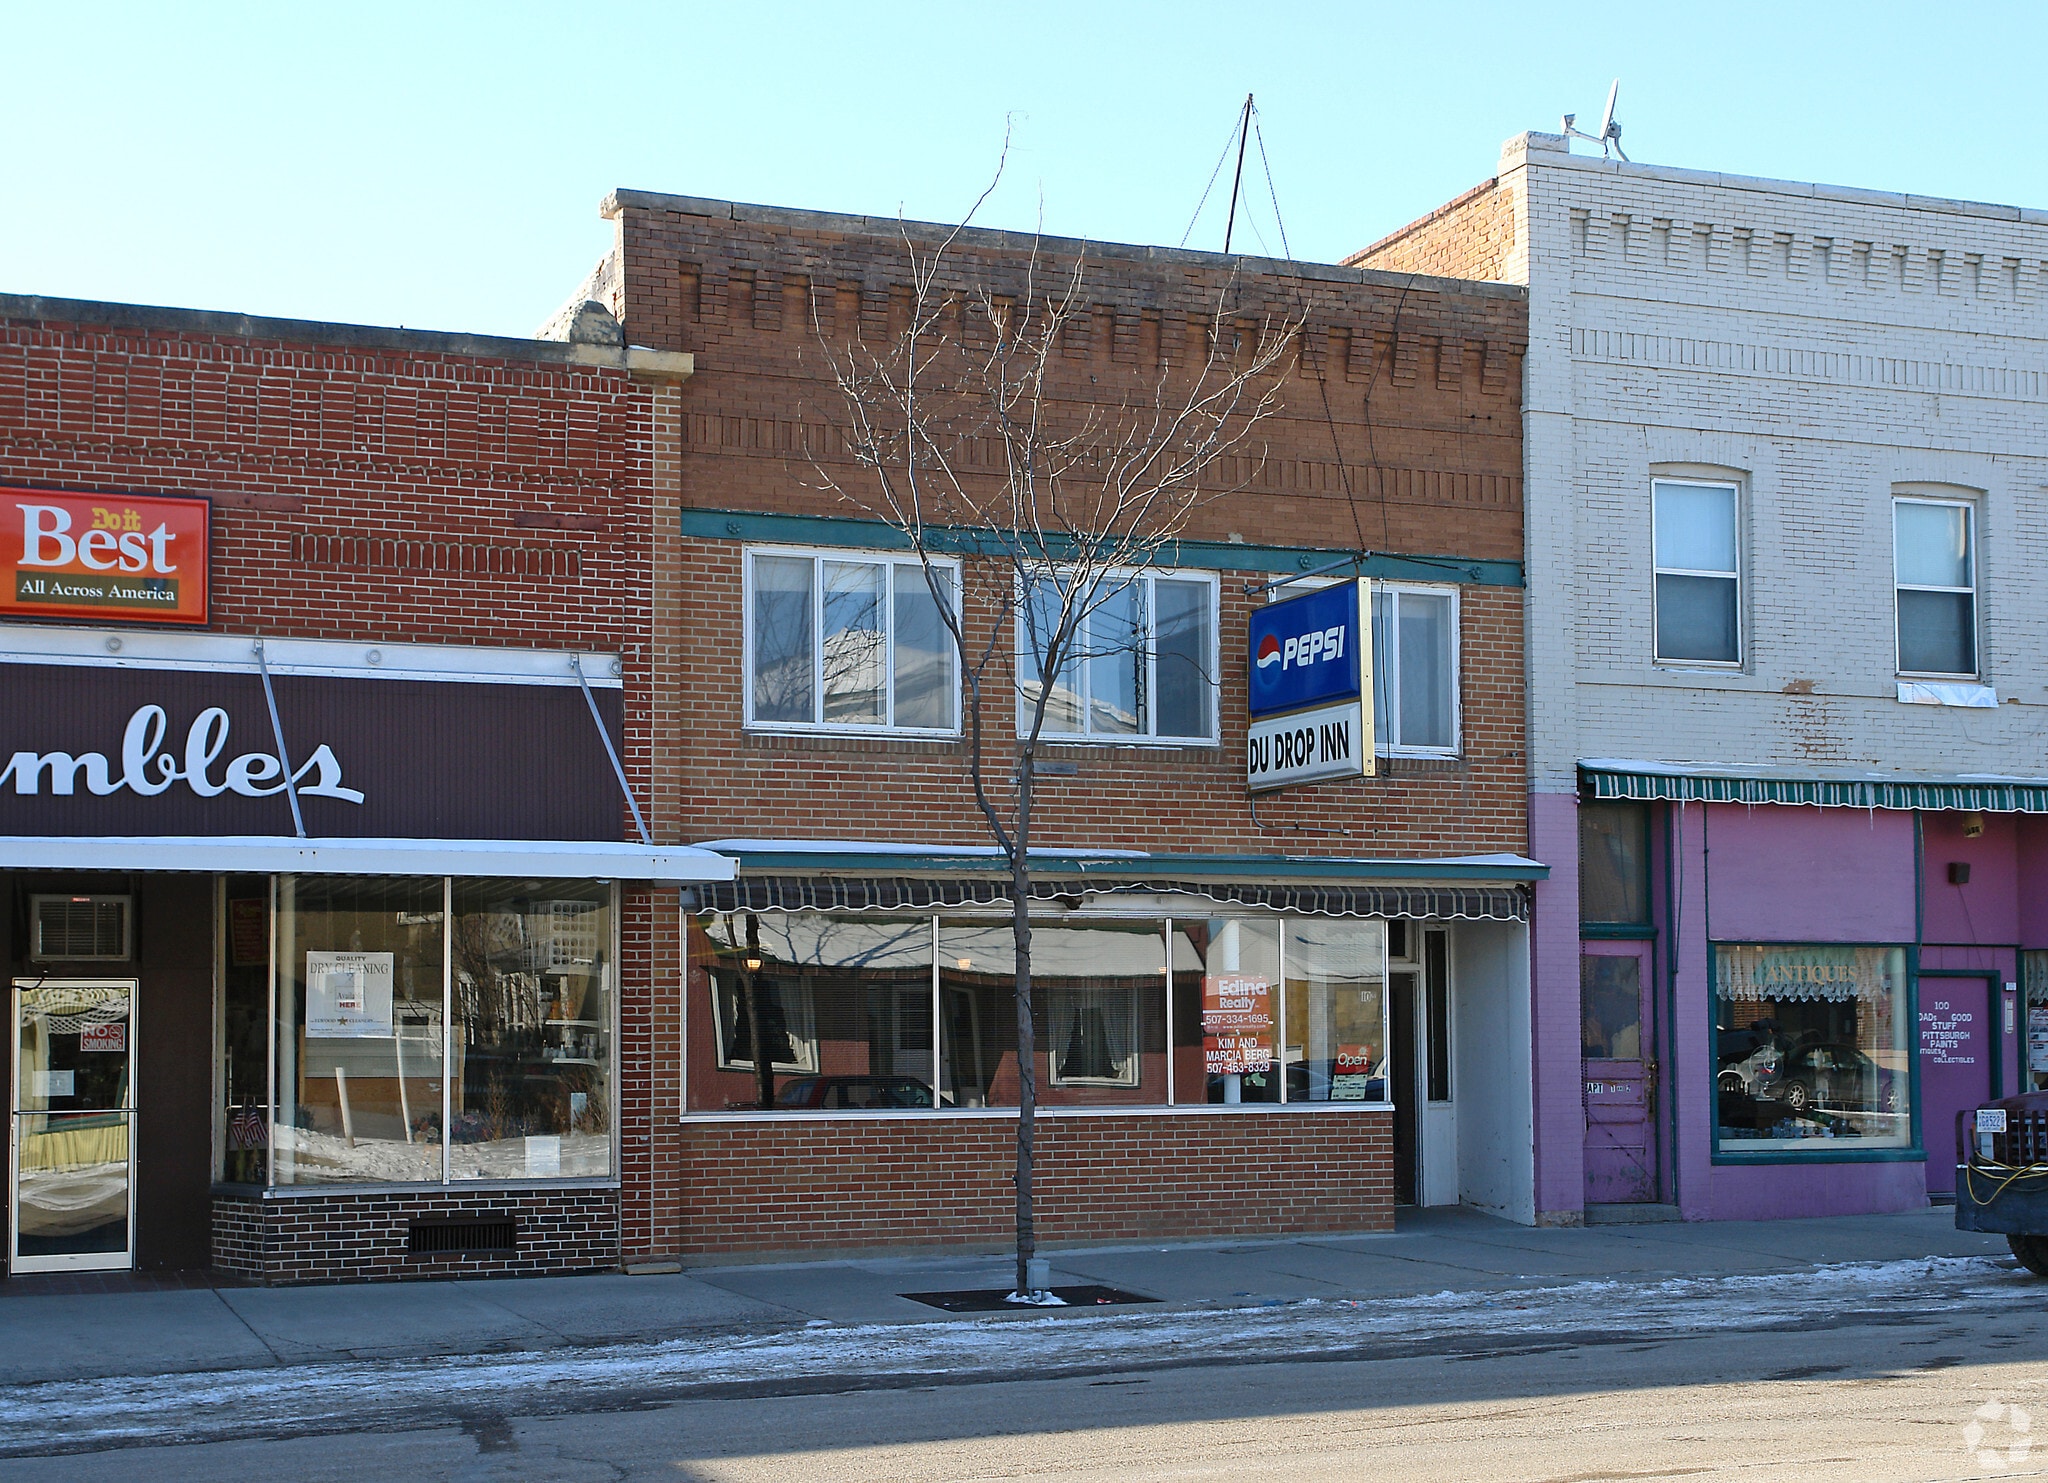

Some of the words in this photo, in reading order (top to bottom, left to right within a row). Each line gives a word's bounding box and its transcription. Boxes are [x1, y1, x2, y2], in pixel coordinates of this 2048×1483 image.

[92, 507, 121, 530] Do
[123, 508, 142, 532] it
[15, 503, 177, 573] Best
[20, 580, 46, 595] All
[50, 581, 104, 598] Across
[108, 584, 175, 601] America
[1282, 625, 1345, 671] PEPSI
[1249, 735, 1269, 774] DU
[1274, 727, 1315, 770] DROP
[1320, 720, 1350, 763] INN
[310, 963, 332, 974] DRY
[335, 963, 389, 975] CLEANING
[1766, 965, 1858, 985] ANTIQUES
[1219, 979, 1267, 996] Edina
[1219, 997, 1256, 1010] Realty
[1934, 1001, 1950, 1010] 100
[1206, 1014, 1269, 1024] 507-334-1695
[1951, 1013, 1972, 1022] GOOD
[83, 1025, 108, 1037] NO
[1932, 1022, 1957, 1030] STUFF
[1922, 1031, 1971, 1040] PITTSBURGH
[83, 1038, 122, 1050] SMOKING
[1218, 1037, 1235, 1049] KIM
[1238, 1037, 1258, 1048] AND
[1930, 1040, 1958, 1048] PAINTS
[1206, 1050, 1242, 1061] MARCIA
[1245, 1049, 1270, 1060] BERG
[1941, 1049, 1947, 1058] &
[1337, 1053, 1367, 1068] Open
[1206, 1061, 1270, 1073] 507-463-8329
[1587, 1083, 1603, 1093] APT
